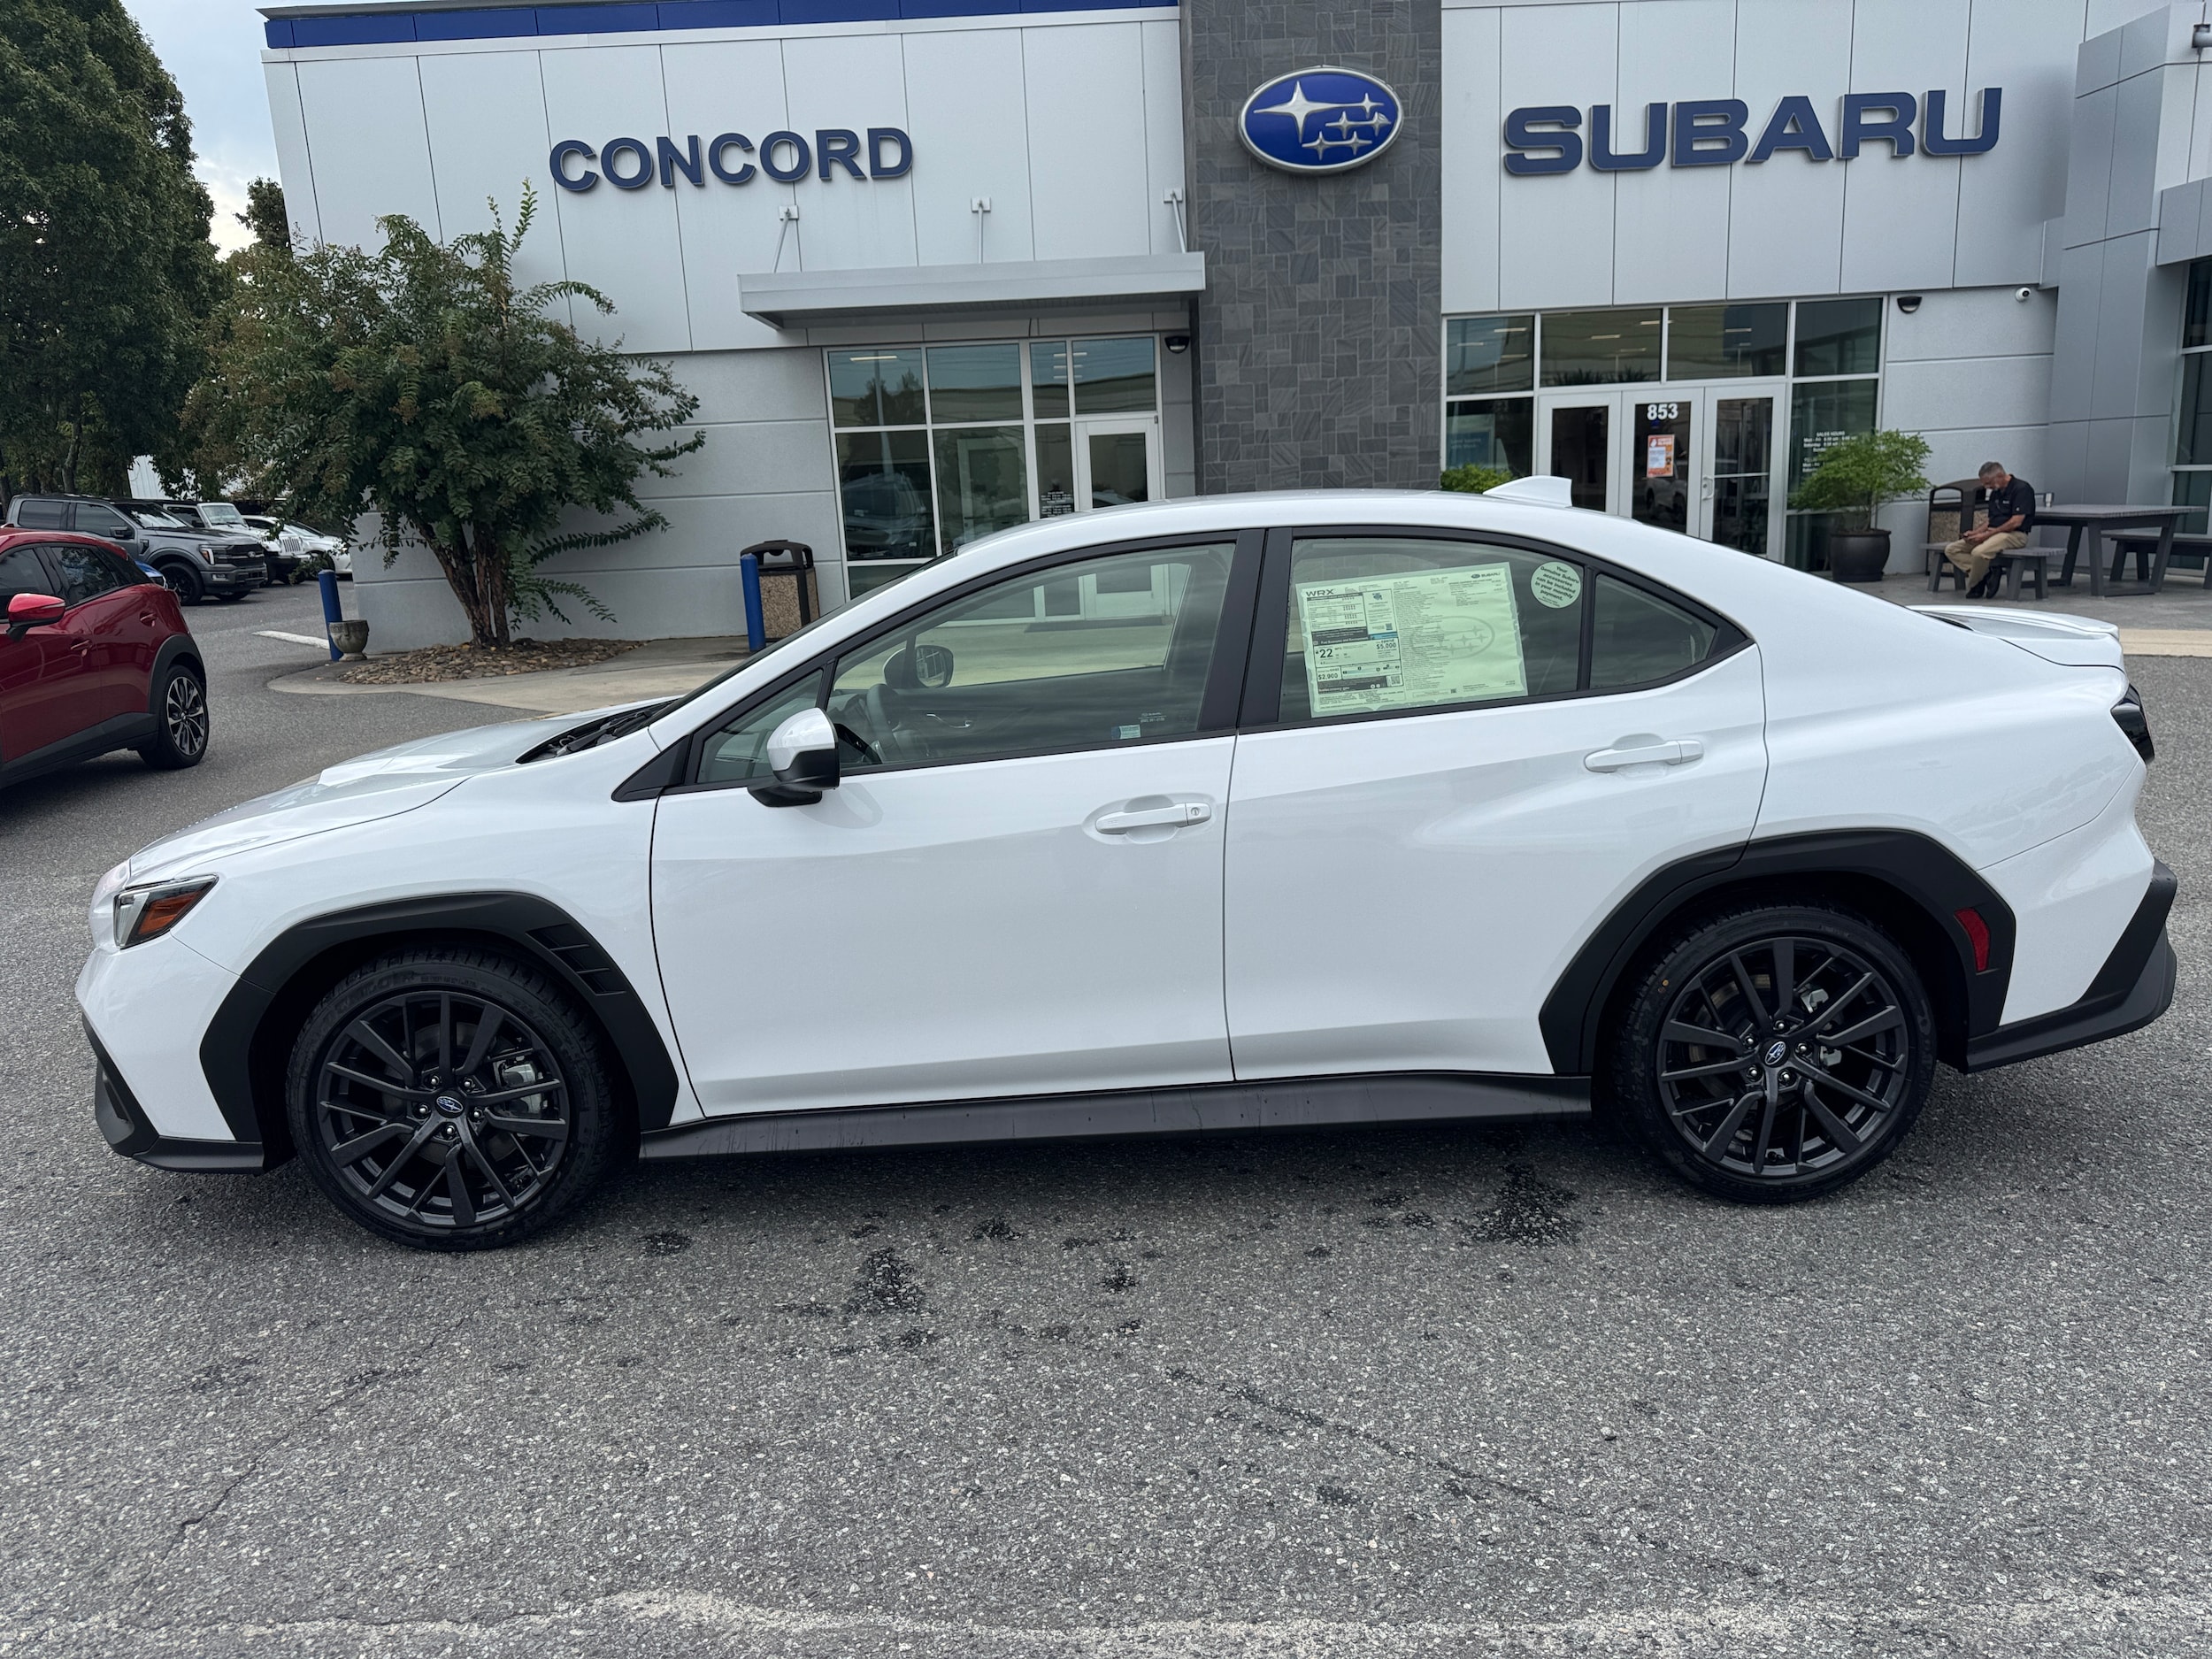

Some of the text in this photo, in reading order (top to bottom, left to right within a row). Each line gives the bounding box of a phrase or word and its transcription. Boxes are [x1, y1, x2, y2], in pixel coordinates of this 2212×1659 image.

[1503, 87, 2002, 176] SUBARU
[549, 127, 914, 192] CONCORD
[1647, 403, 1678, 420] 853
[1540, 566, 1579, 584] Genuine Subaru
[1543, 573, 1572, 587] accessories
[1319, 649, 1333, 658] 22
